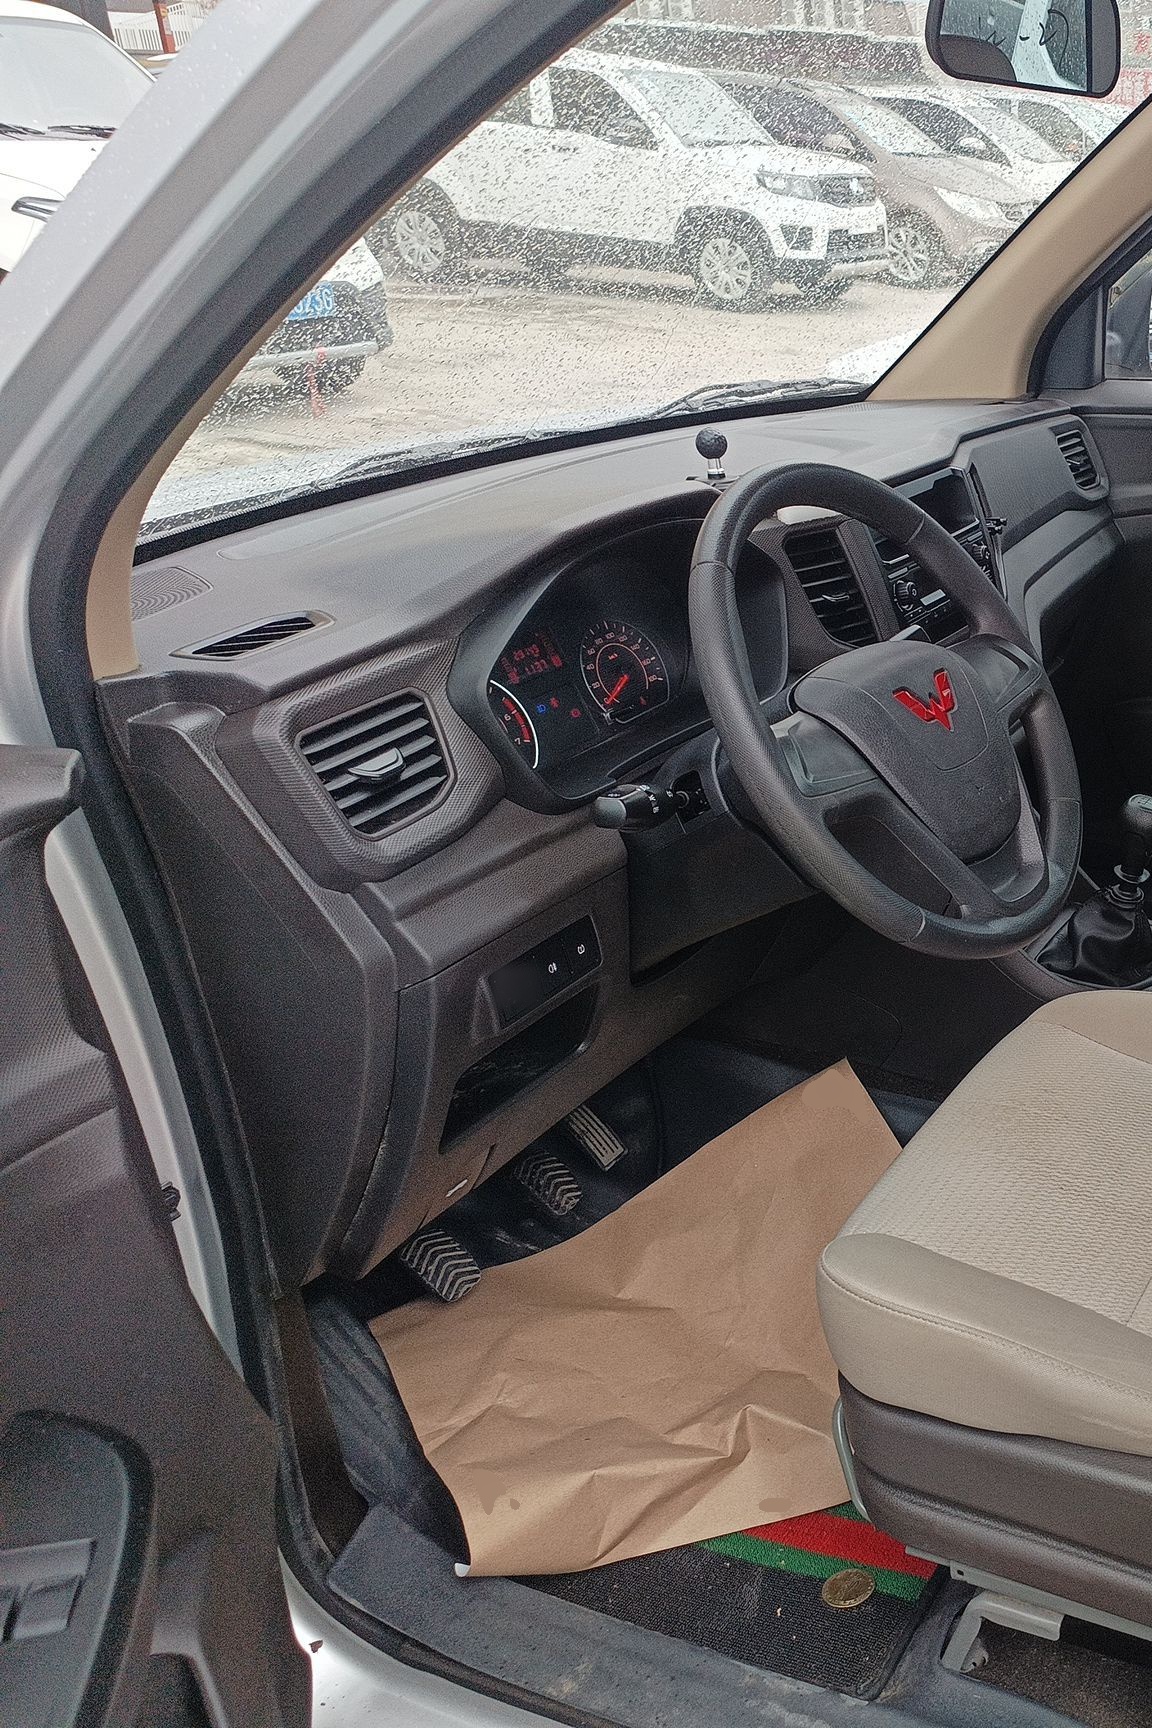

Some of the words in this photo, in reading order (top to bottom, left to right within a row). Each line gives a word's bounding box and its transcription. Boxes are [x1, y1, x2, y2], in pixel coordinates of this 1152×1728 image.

[605, 632, 615, 640] 100
[586, 663, 595, 671] 40
[592, 681, 600, 689] 20
[504, 713, 511, 721] 6
[514, 737, 521, 745] 7
